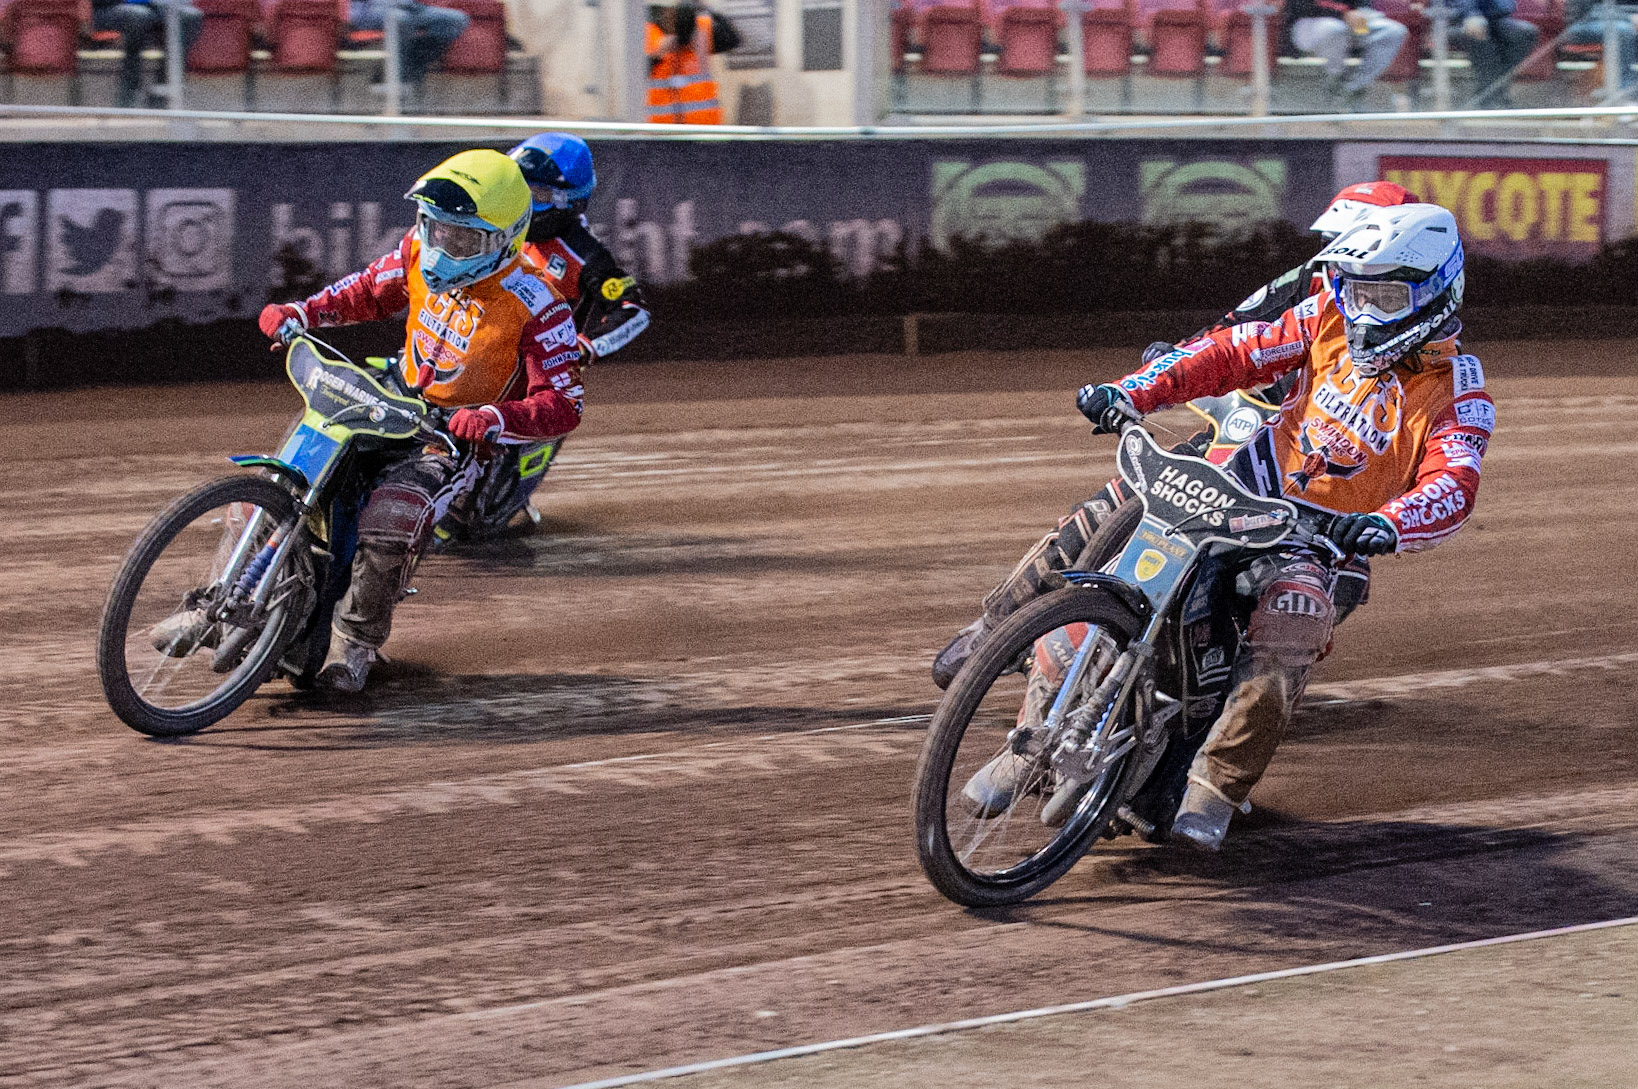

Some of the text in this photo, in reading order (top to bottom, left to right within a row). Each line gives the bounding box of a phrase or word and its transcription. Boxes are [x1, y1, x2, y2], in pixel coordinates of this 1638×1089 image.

[419, 310, 469, 352] FILTRATION
[1310, 417, 1367, 463] SWINDON
[1314, 386, 1388, 452] FILTRATION
[1150, 480, 1225, 527] SHOCKS
[1158, 465, 1236, 511] HAGON
[1398, 490, 1466, 530] SHOCKS
